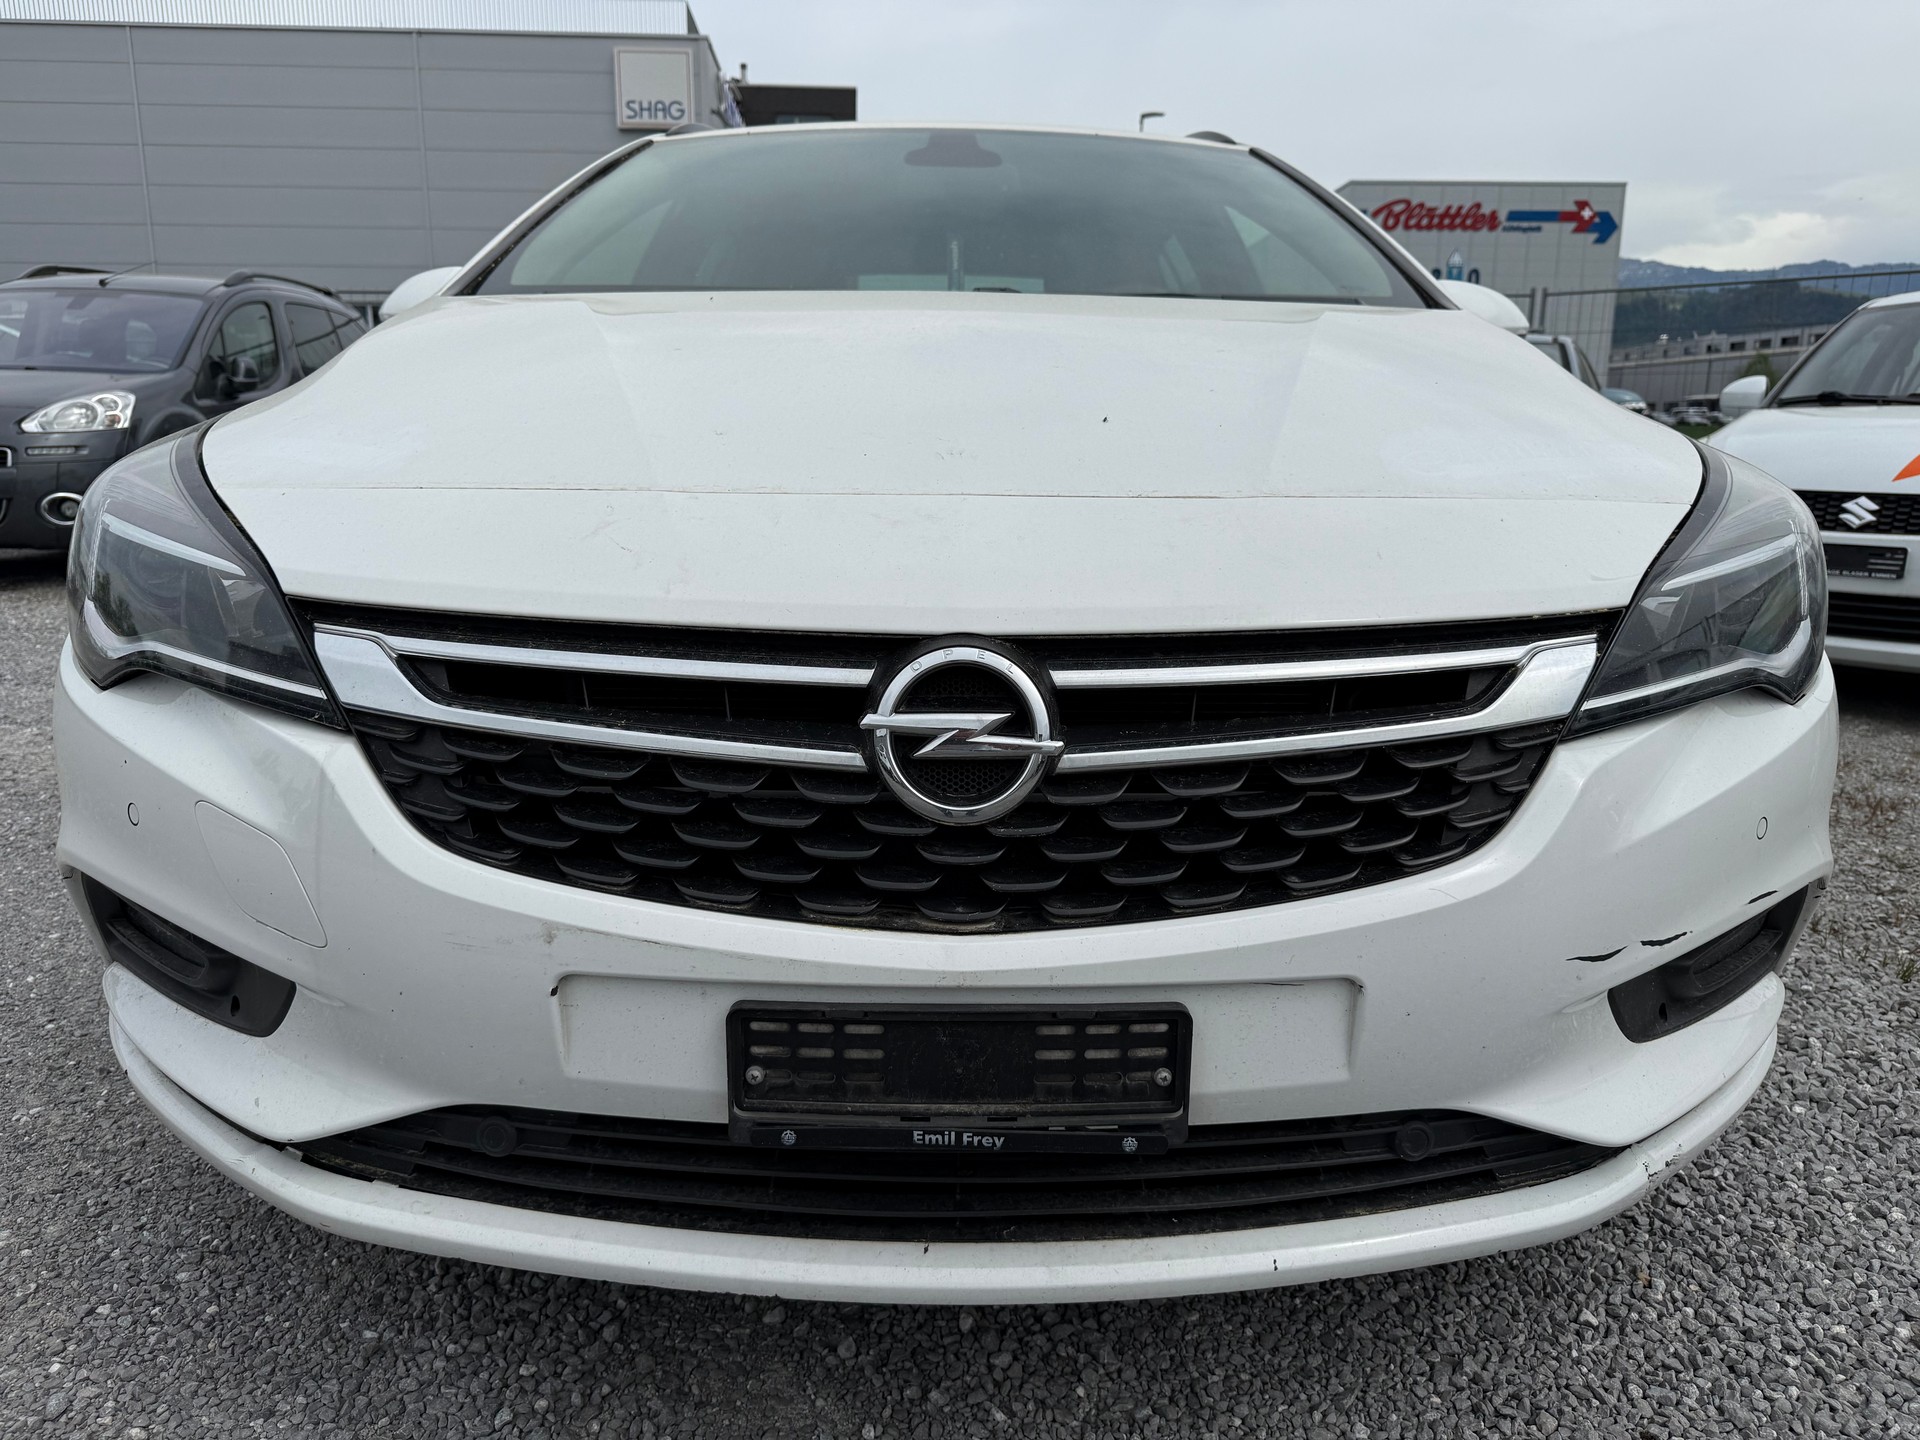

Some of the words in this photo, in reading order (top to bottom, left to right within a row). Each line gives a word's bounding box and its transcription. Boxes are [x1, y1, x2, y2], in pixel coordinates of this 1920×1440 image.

[625, 100, 686, 121] SHAG
[910, 649, 1014, 675] OPEL
[912, 1130, 956, 1146] Emil
[962, 1132, 1005, 1150] Frey
